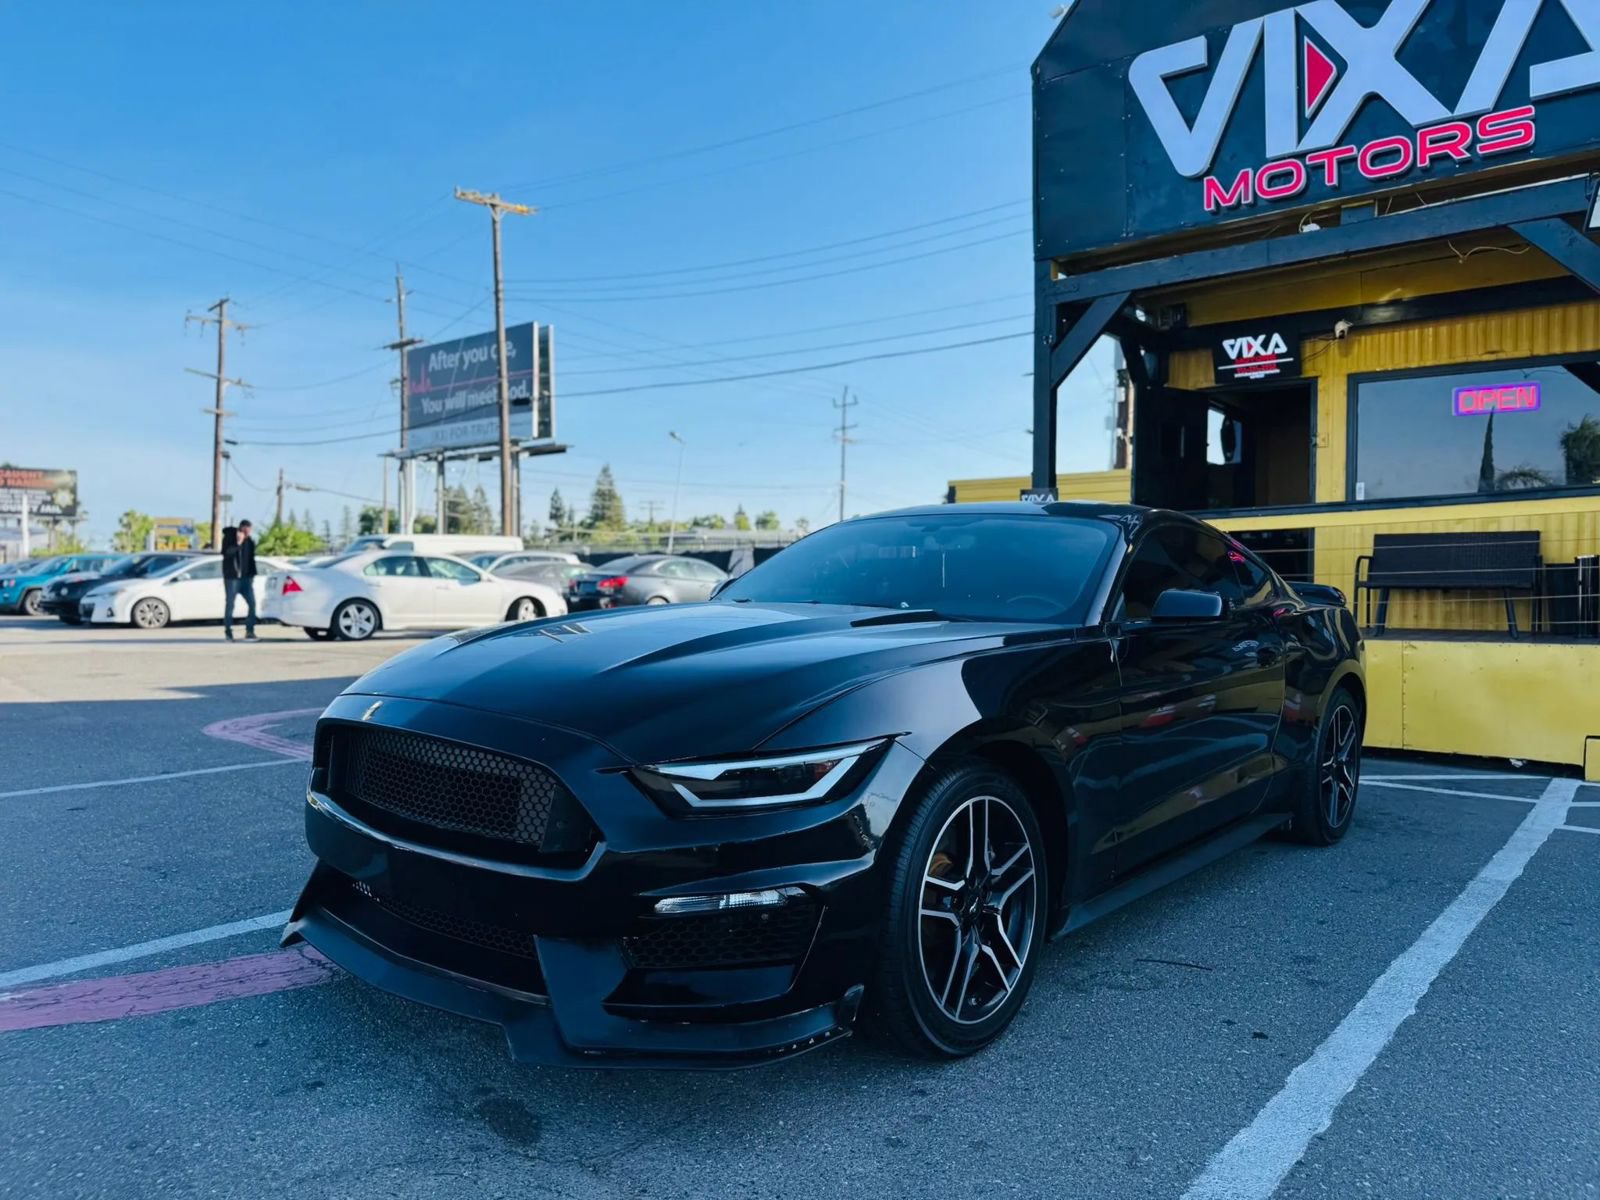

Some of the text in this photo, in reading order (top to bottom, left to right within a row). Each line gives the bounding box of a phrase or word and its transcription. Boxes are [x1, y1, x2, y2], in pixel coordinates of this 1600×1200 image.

[1128, 0, 1600, 177] VIXA
[1203, 105, 1536, 212] MOTORS
[428, 350, 460, 372] After
[462, 346, 488, 370] you
[1222, 332, 1288, 360] VIXA
[421, 398, 440, 415] You
[1459, 386, 1537, 413] OPEN
